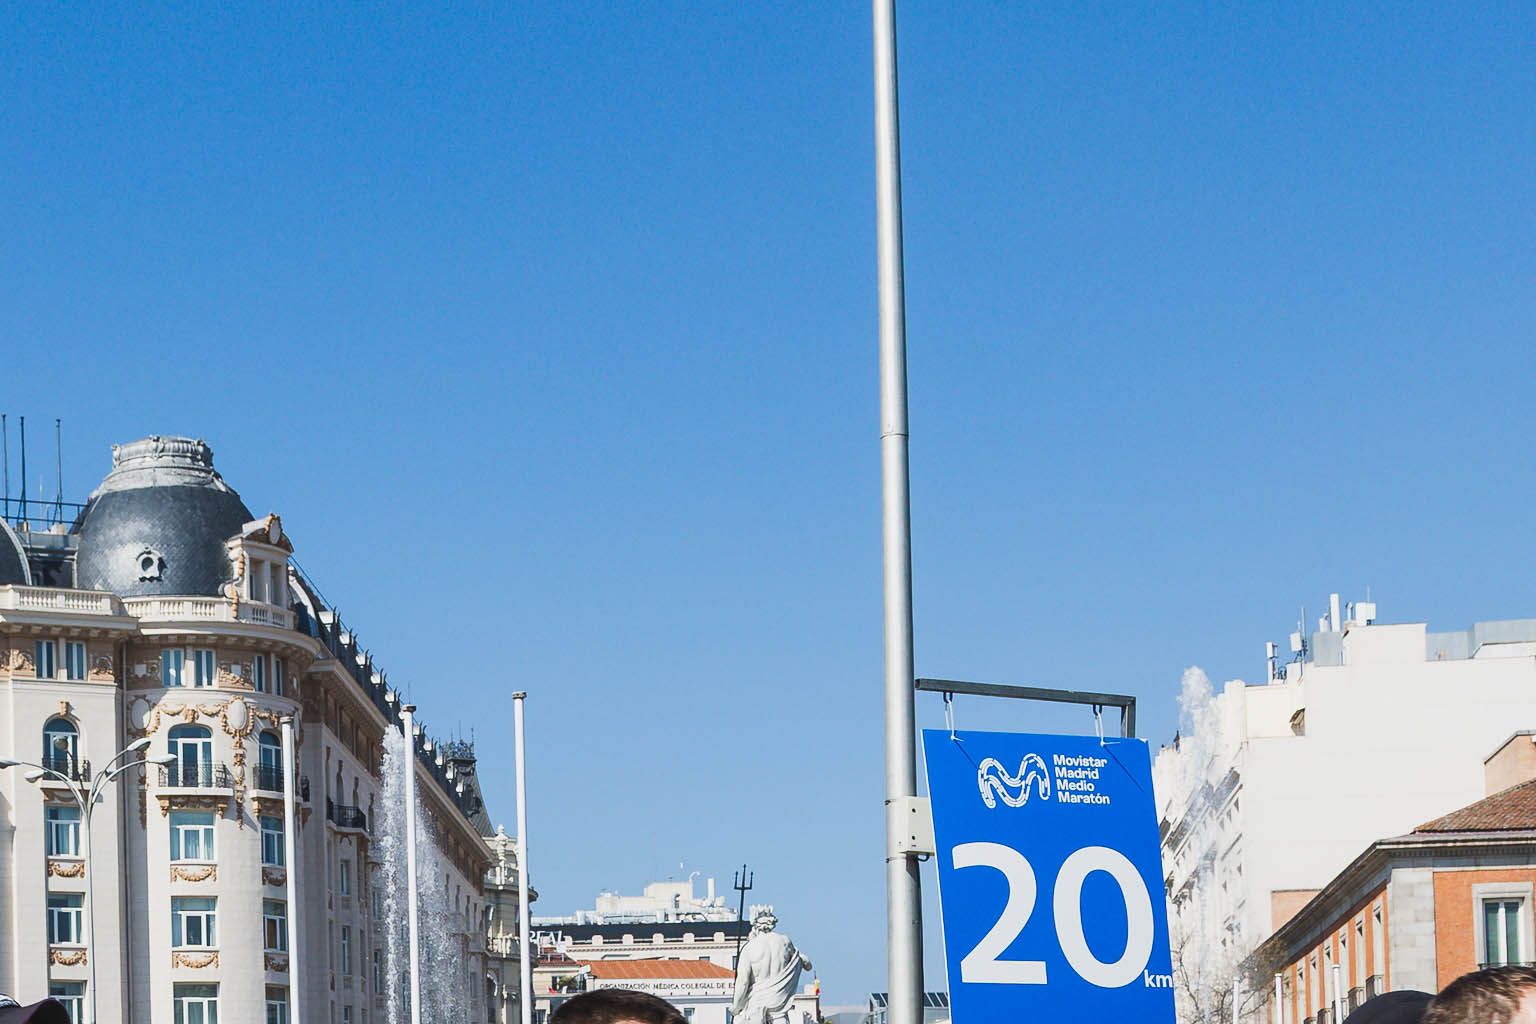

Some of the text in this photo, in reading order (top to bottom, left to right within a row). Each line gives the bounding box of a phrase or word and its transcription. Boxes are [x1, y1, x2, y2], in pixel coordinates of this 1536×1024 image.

[1052, 753, 1108, 768] Movistar
[1054, 766, 1100, 780] Madrid
[1056, 778, 1096, 792] Medio
[1057, 791, 1111, 805] Maratón
[951, 841, 1175, 989] 20 km
[653, 981, 679, 990] MÉDICA
[680, 982, 714, 990] COLEGIAL
